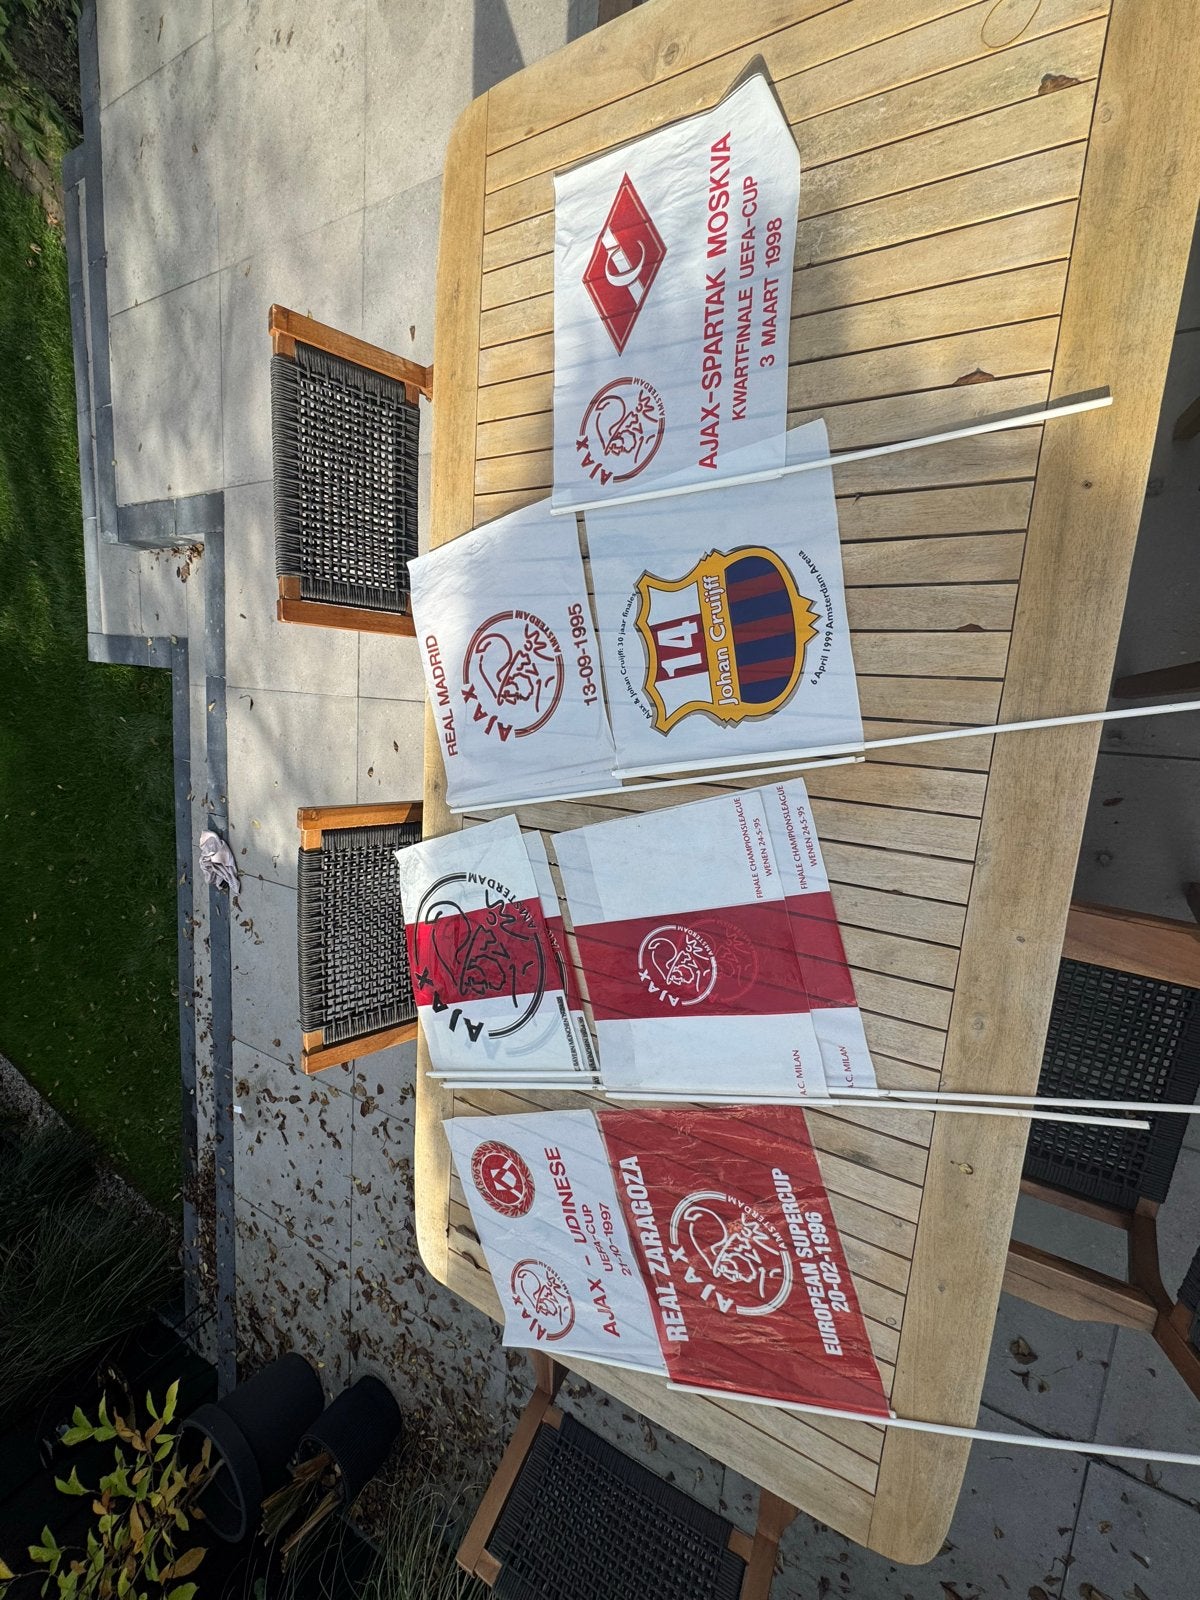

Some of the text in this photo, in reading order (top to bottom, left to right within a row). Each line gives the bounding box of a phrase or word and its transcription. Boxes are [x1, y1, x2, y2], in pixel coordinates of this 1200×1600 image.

[698, 131, 731, 469] AJAX-SPARTAK MOSKVA
[732, 176, 758, 421] KWARTFINALE UEFA-CUP
[760, 217, 782, 367] 3 MAART 1998
[631, 377, 666, 418] AMSTERDAM
[576, 435, 613, 485] AJAX
[798, 550, 819, 574] Arena
[814, 574, 834, 629] Amsterdam
[515, 610, 562, 654] AMSTERDAM
[568, 603, 597, 706] 13-09-1995
[618, 637, 624, 646] 30
[657, 620, 703, 677] 14
[703, 574, 739, 706] Johan Cruijff
[822, 631, 833, 652] 1999
[618, 648, 627, 675] Cruijff:
[624, 676, 637, 697] Johan
[814, 655, 829, 679] April
[425, 635, 458, 756] REAL MADRID
[461, 684, 513, 742] AJAX
[639, 704, 650, 719] Ajax
[734, 797, 763, 898] FINALE CHAMPIONSLEAGUE
[760, 848, 772, 876] WENEN
[776, 785, 808, 889] FINALE CHAMPIONSLEAGUE
[804, 837, 817, 866] WENEN
[467, 872, 536, 929] AMSTERDAM
[676, 926, 714, 956] AMSTERDAM
[415, 966, 484, 1042] AJAX
[638, 969, 680, 1007] AJAX
[792, 1050, 807, 1095] A.C. MILAN
[839, 1046, 851, 1072] MILAN
[544, 1146, 588, 1244] UDINESE
[726, 1194, 788, 1250] AMSTERDAM
[581, 1203, 614, 1272] UEFA-CUP
[599, 1202, 632, 1276] 21-10-1997
[619, 1155, 689, 1342] REAL ZARAGOZA
[771, 1167, 843, 1356] EUROPEAN SUPERCUP
[805, 1211, 851, 1313] 20-02-1996
[537, 1260, 571, 1295] AMSTERDAM
[668, 1245, 735, 1313] AJAX
[512, 1294, 547, 1340] AJAX
[587, 1278, 620, 1338] AJAX
